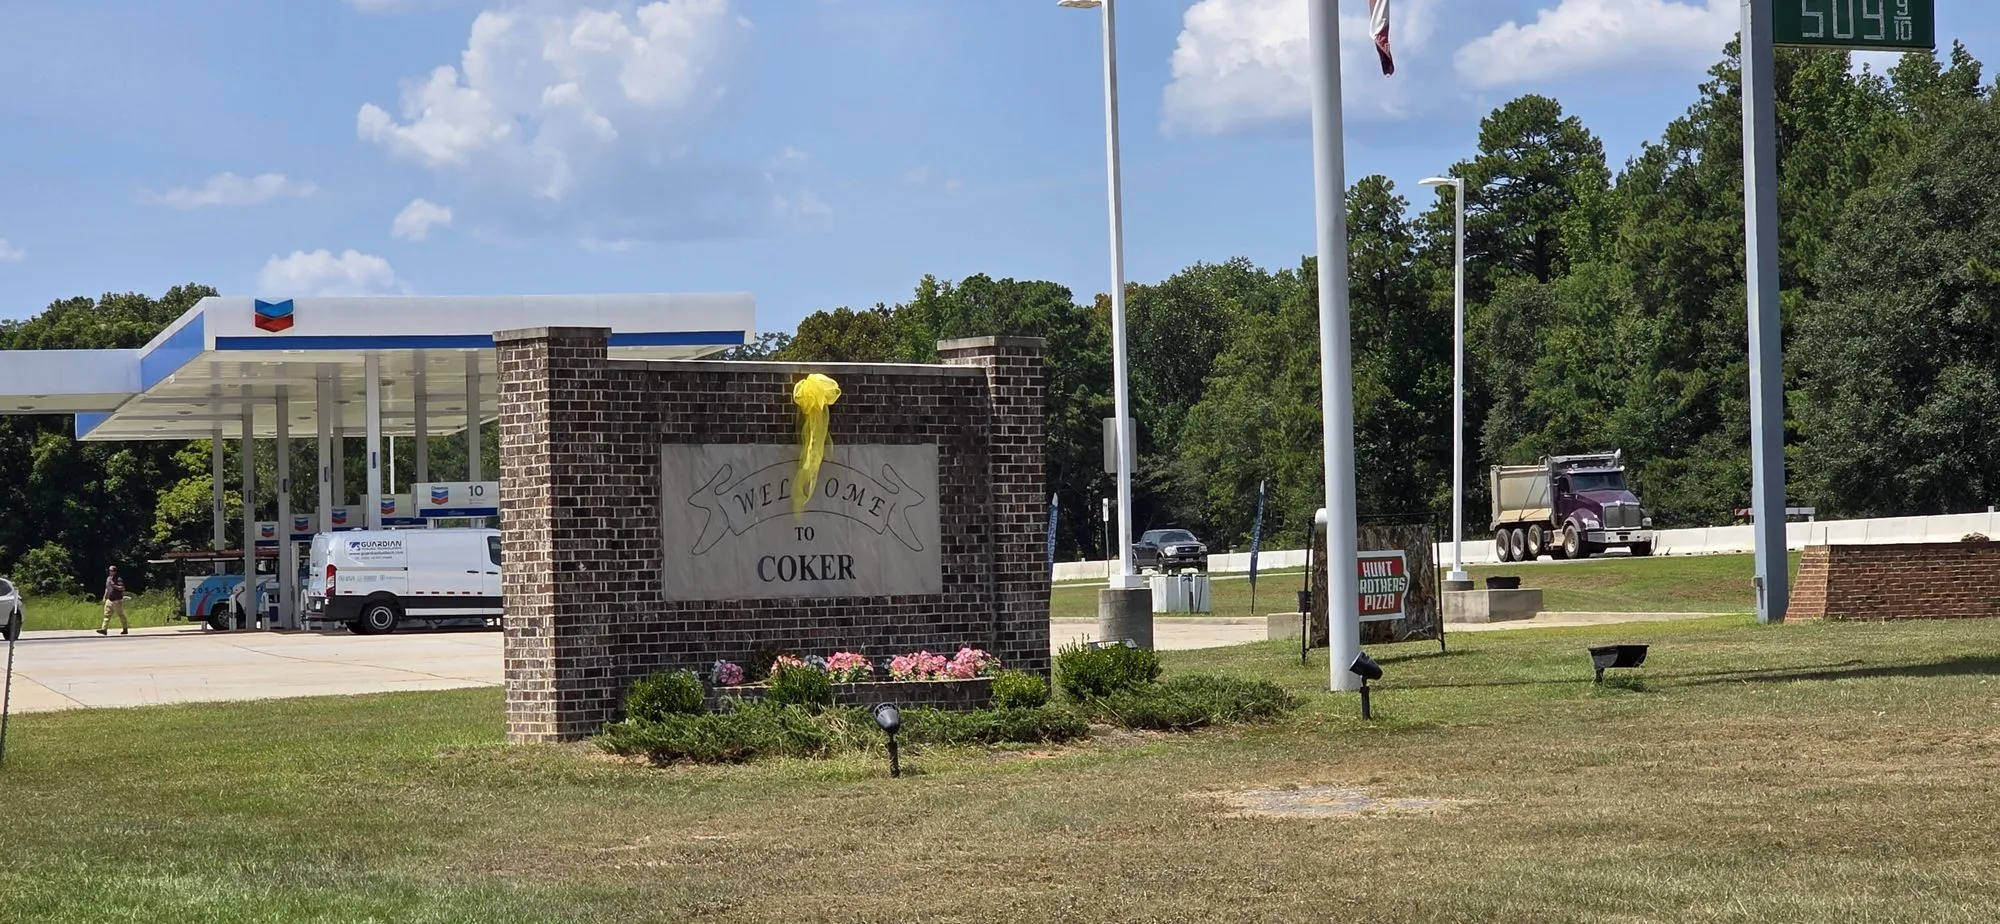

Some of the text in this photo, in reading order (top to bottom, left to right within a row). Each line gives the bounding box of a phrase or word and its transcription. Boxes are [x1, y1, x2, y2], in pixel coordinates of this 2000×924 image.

[1894, 20, 1913, 41] 10
[468, 485, 484, 497] 10
[795, 526, 815, 541] TO
[361, 540, 402, 548] GUARDIAN
[756, 554, 857, 582] COKER
[1362, 560, 1393, 578] HUNT
[1358, 577, 1406, 594] ROTHERS
[1364, 593, 1395, 611] PIZZA
